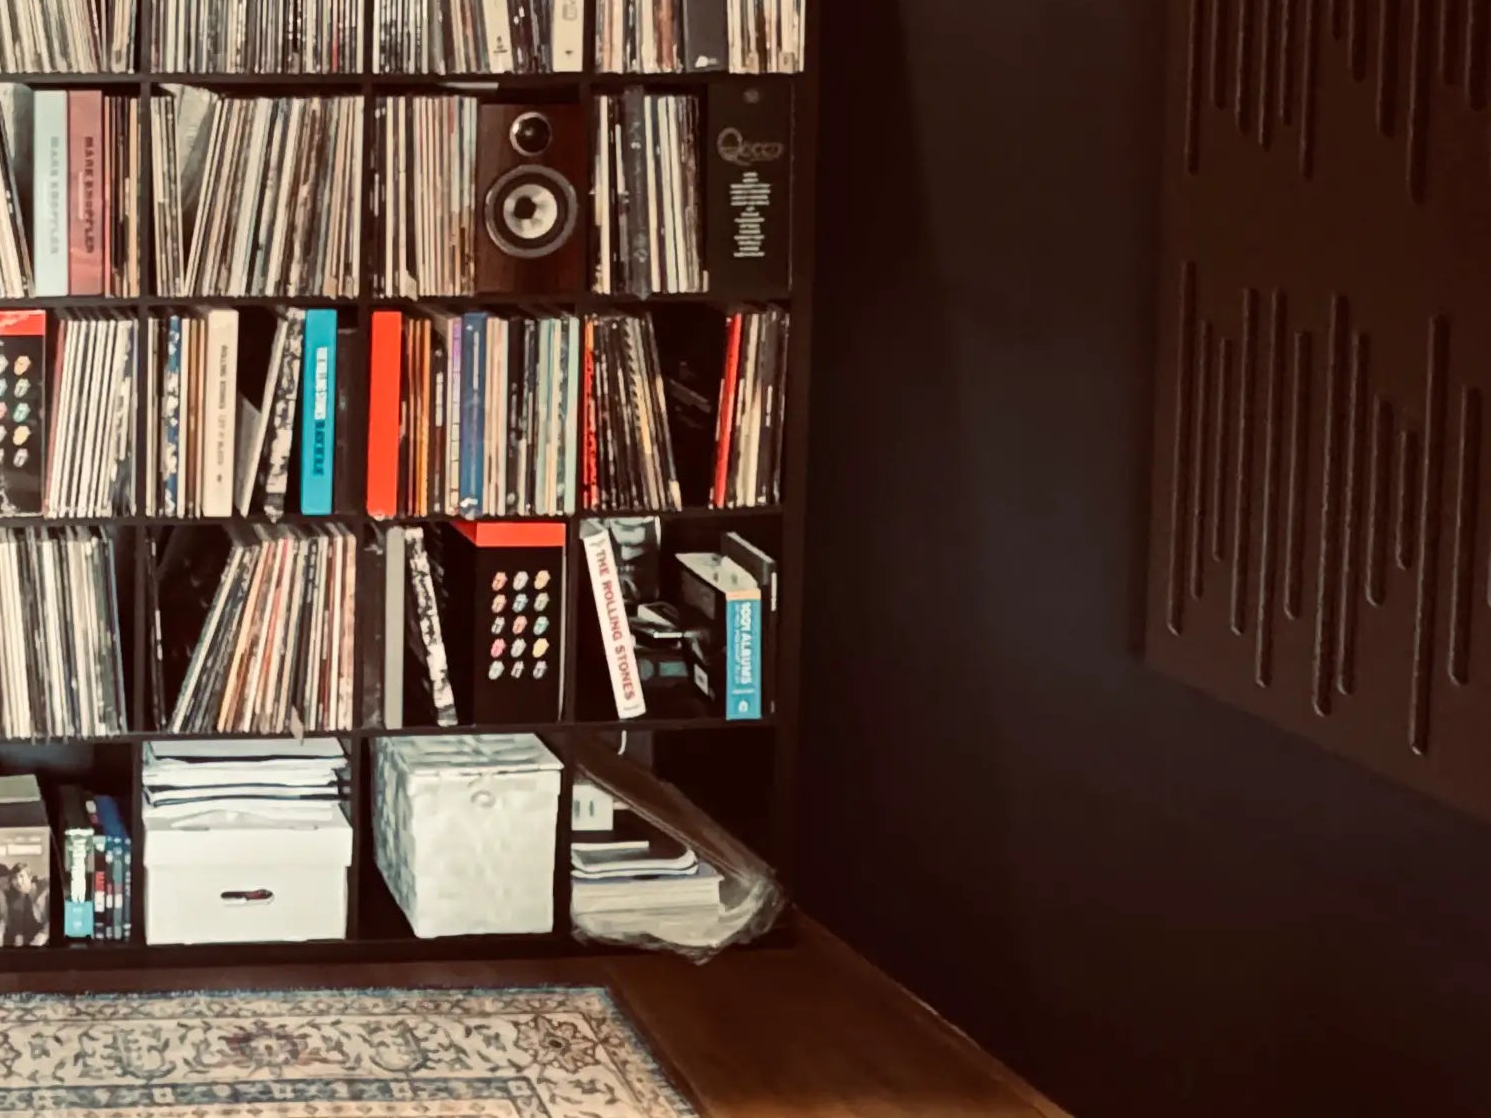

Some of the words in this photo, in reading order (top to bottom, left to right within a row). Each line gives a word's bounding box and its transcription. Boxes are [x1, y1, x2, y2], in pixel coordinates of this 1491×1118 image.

[595, 549, 610, 577] THE
[602, 580, 623, 641] ROLLING
[614, 645, 636, 701] STONES
